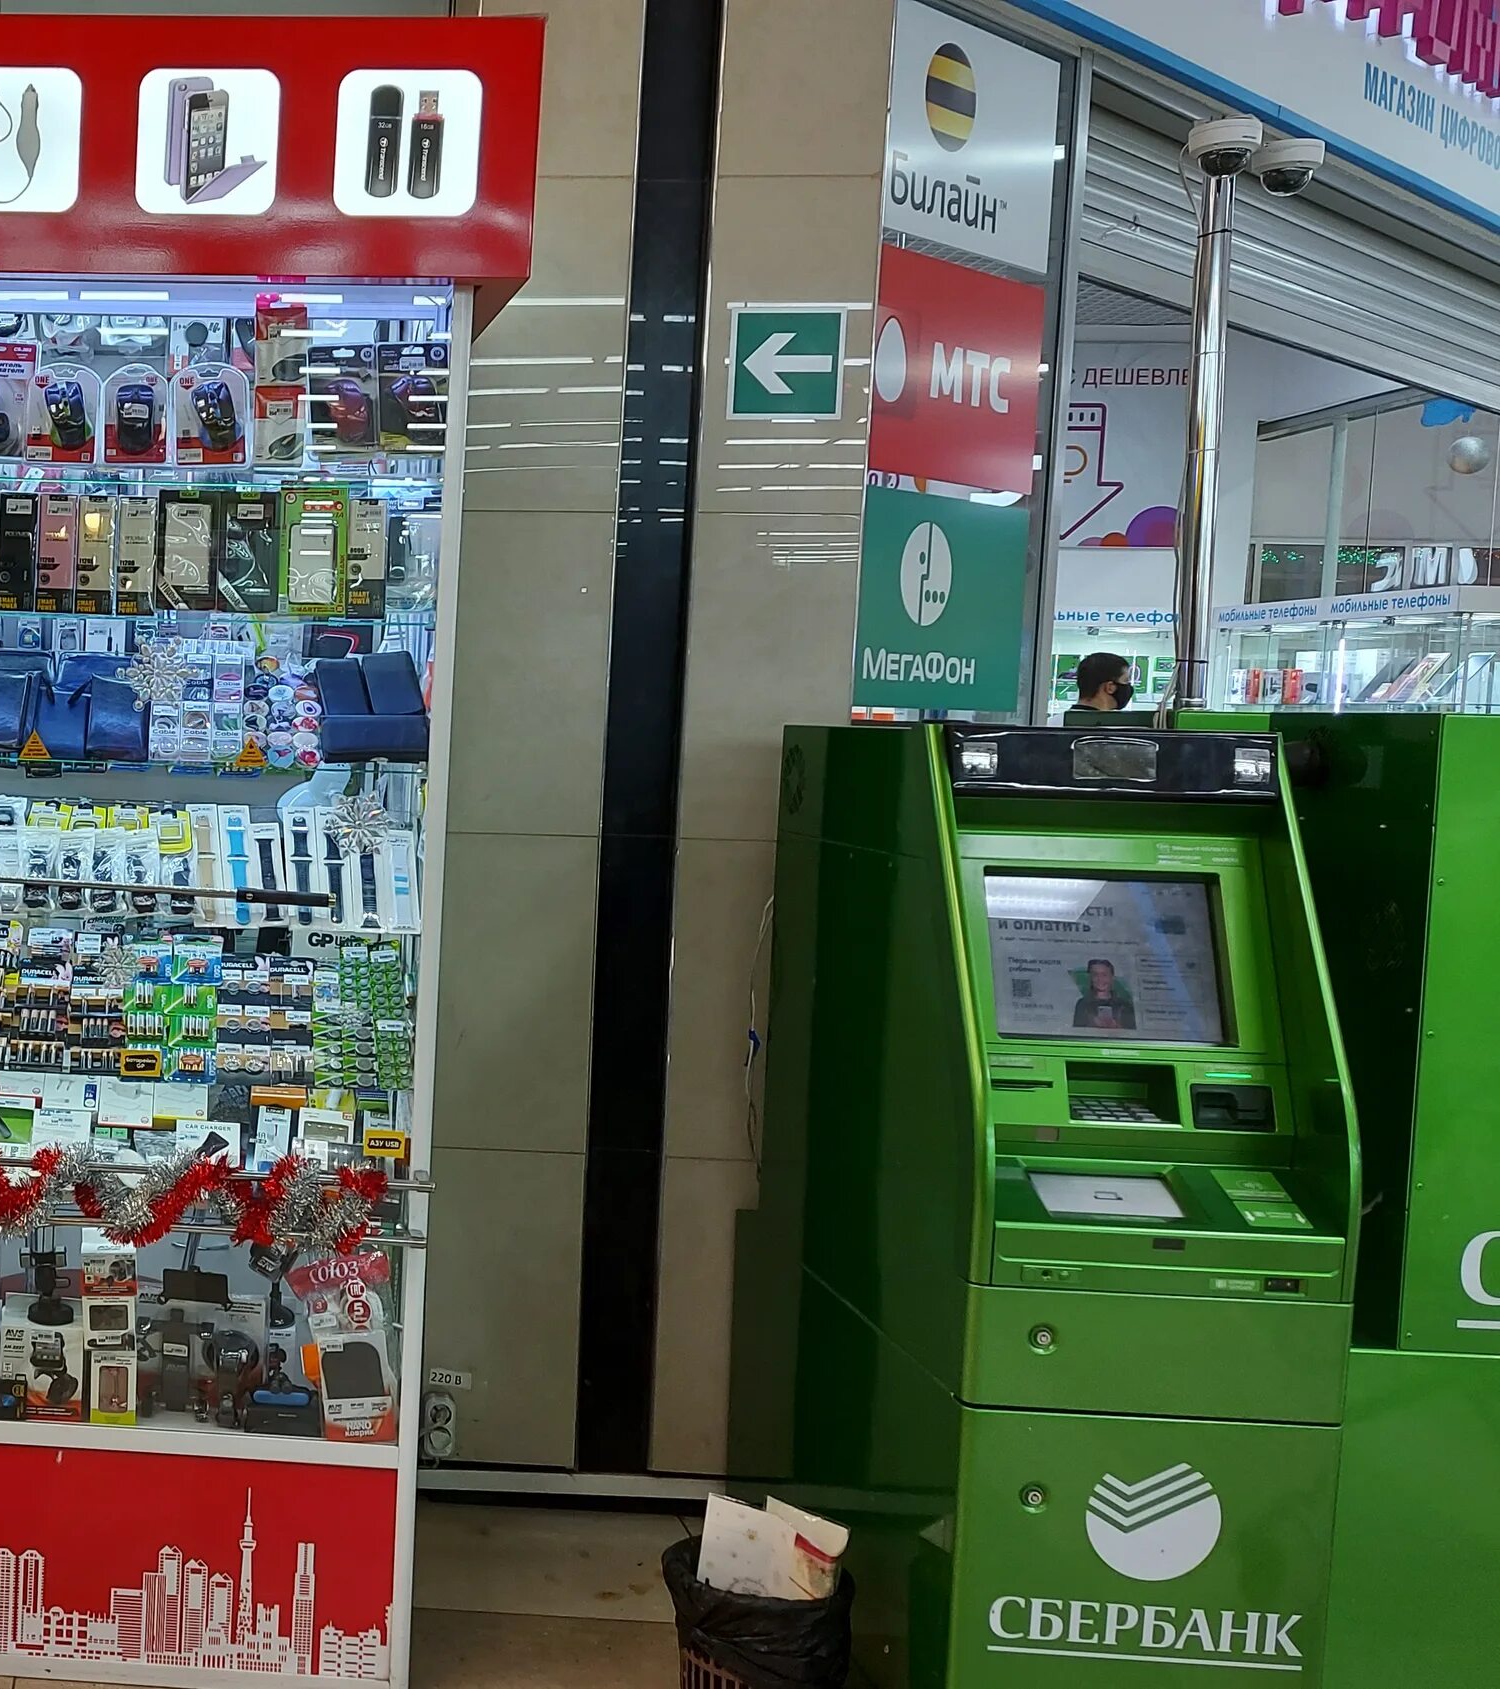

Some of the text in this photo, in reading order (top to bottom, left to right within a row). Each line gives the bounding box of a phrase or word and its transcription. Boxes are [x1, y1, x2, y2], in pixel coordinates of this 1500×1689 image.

[1364, 62, 1435, 134] МАГАЗИН
[930, 341, 1012, 413] МТС
[1330, 592, 1451, 613] мобильные телефоны
[1218, 604, 1317, 623] мобильные телефоны
[308, 932, 334, 948] GP
[185, 1123, 232, 1132] CAR CHARGER
[385, 1140, 400, 1148] USB
[352, 1302, 364, 1317] 5
[5, 1328, 26, 1338] AVS
[431, 1371, 451, 1385] 220
[988, 1596, 1303, 1658] СБЕРБАНК
